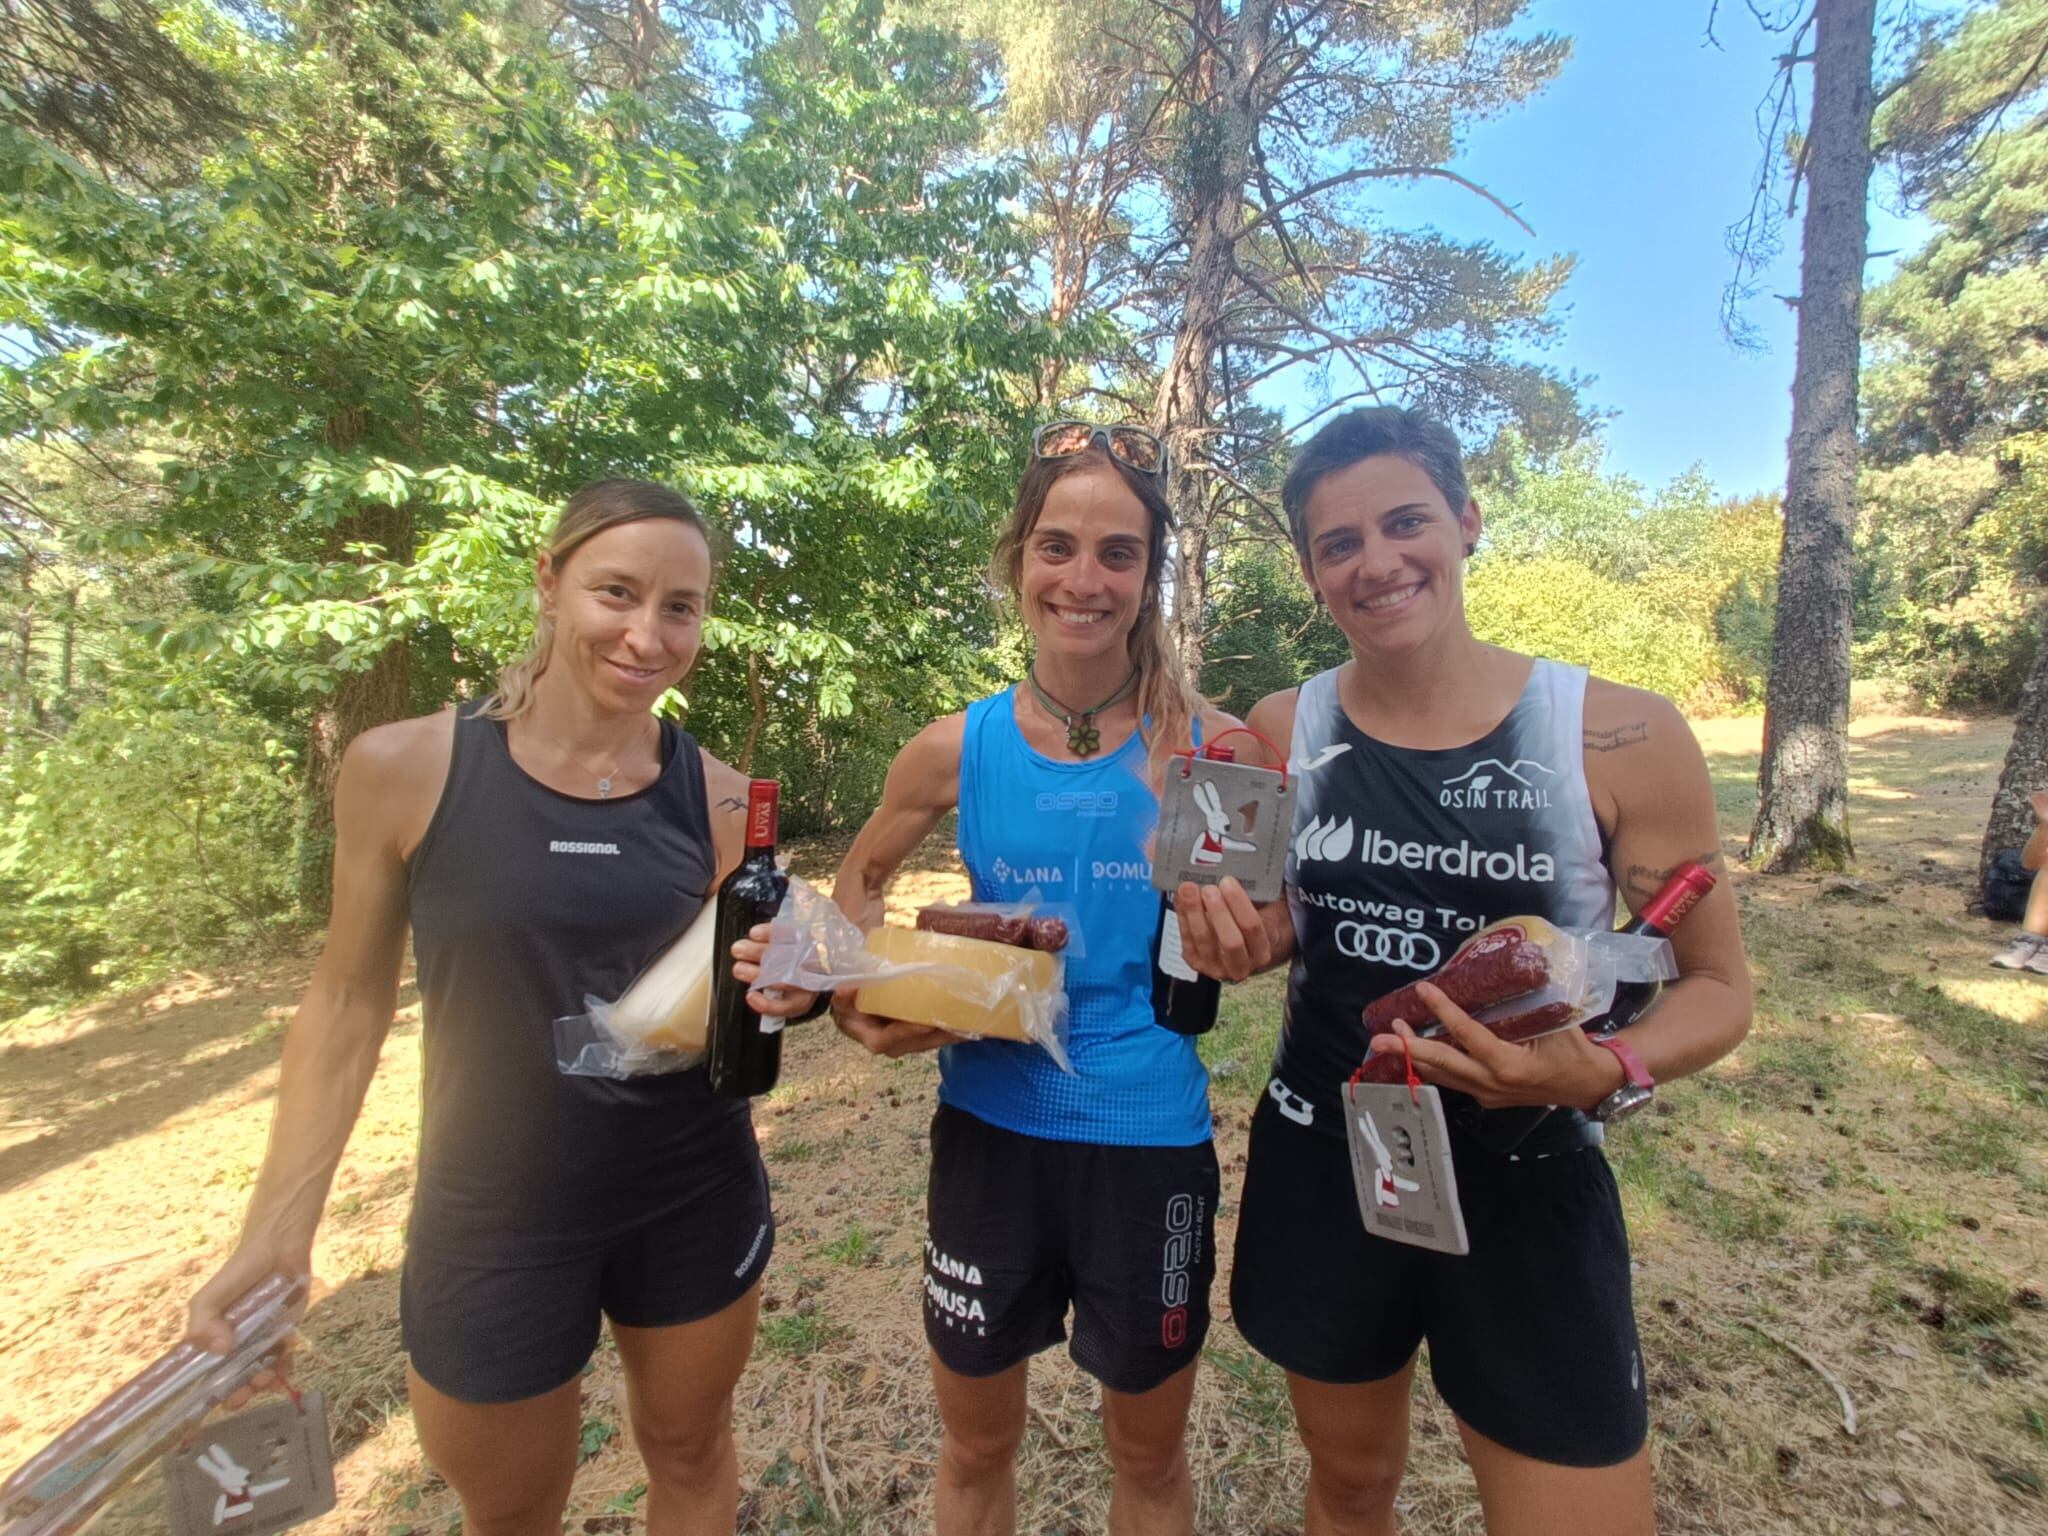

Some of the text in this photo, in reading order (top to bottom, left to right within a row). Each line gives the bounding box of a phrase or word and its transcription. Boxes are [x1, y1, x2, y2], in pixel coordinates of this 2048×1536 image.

[1440, 788, 1553, 810] OSIN TRAIL
[549, 840, 622, 855] ROSSIGNOL
[1361, 828, 1555, 882] Iberdrola
[1012, 860, 1153, 884] LANA DOMU
[1298, 887, 1486, 931] Autowag Tol
[931, 1246, 983, 1285] LANA
[924, 1274, 986, 1322] OMUSA
